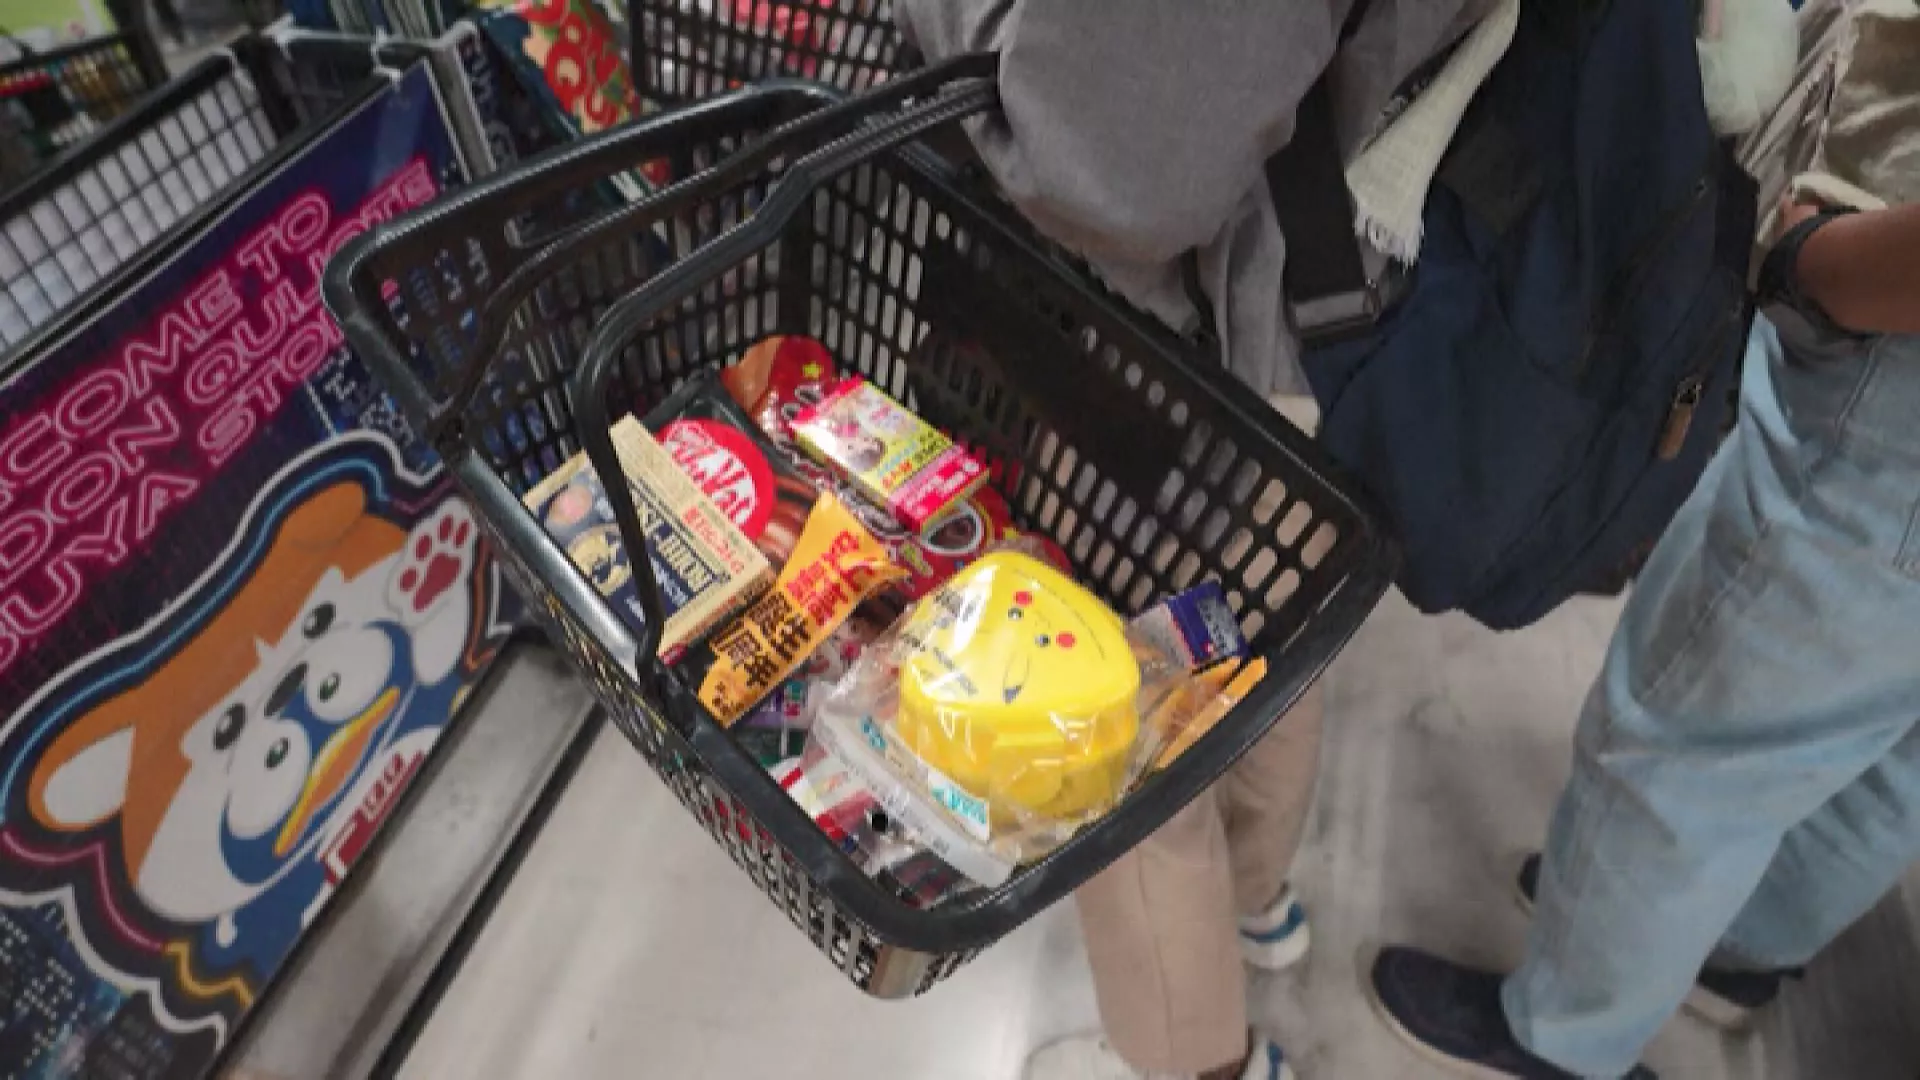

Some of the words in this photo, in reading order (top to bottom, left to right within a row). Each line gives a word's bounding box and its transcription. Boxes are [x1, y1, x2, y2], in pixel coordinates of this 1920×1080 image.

[0, 269, 243, 516] COME
[236, 193, 329, 282] TO
[197, 308, 345, 468] STO
[0, 394, 181, 592] DON
